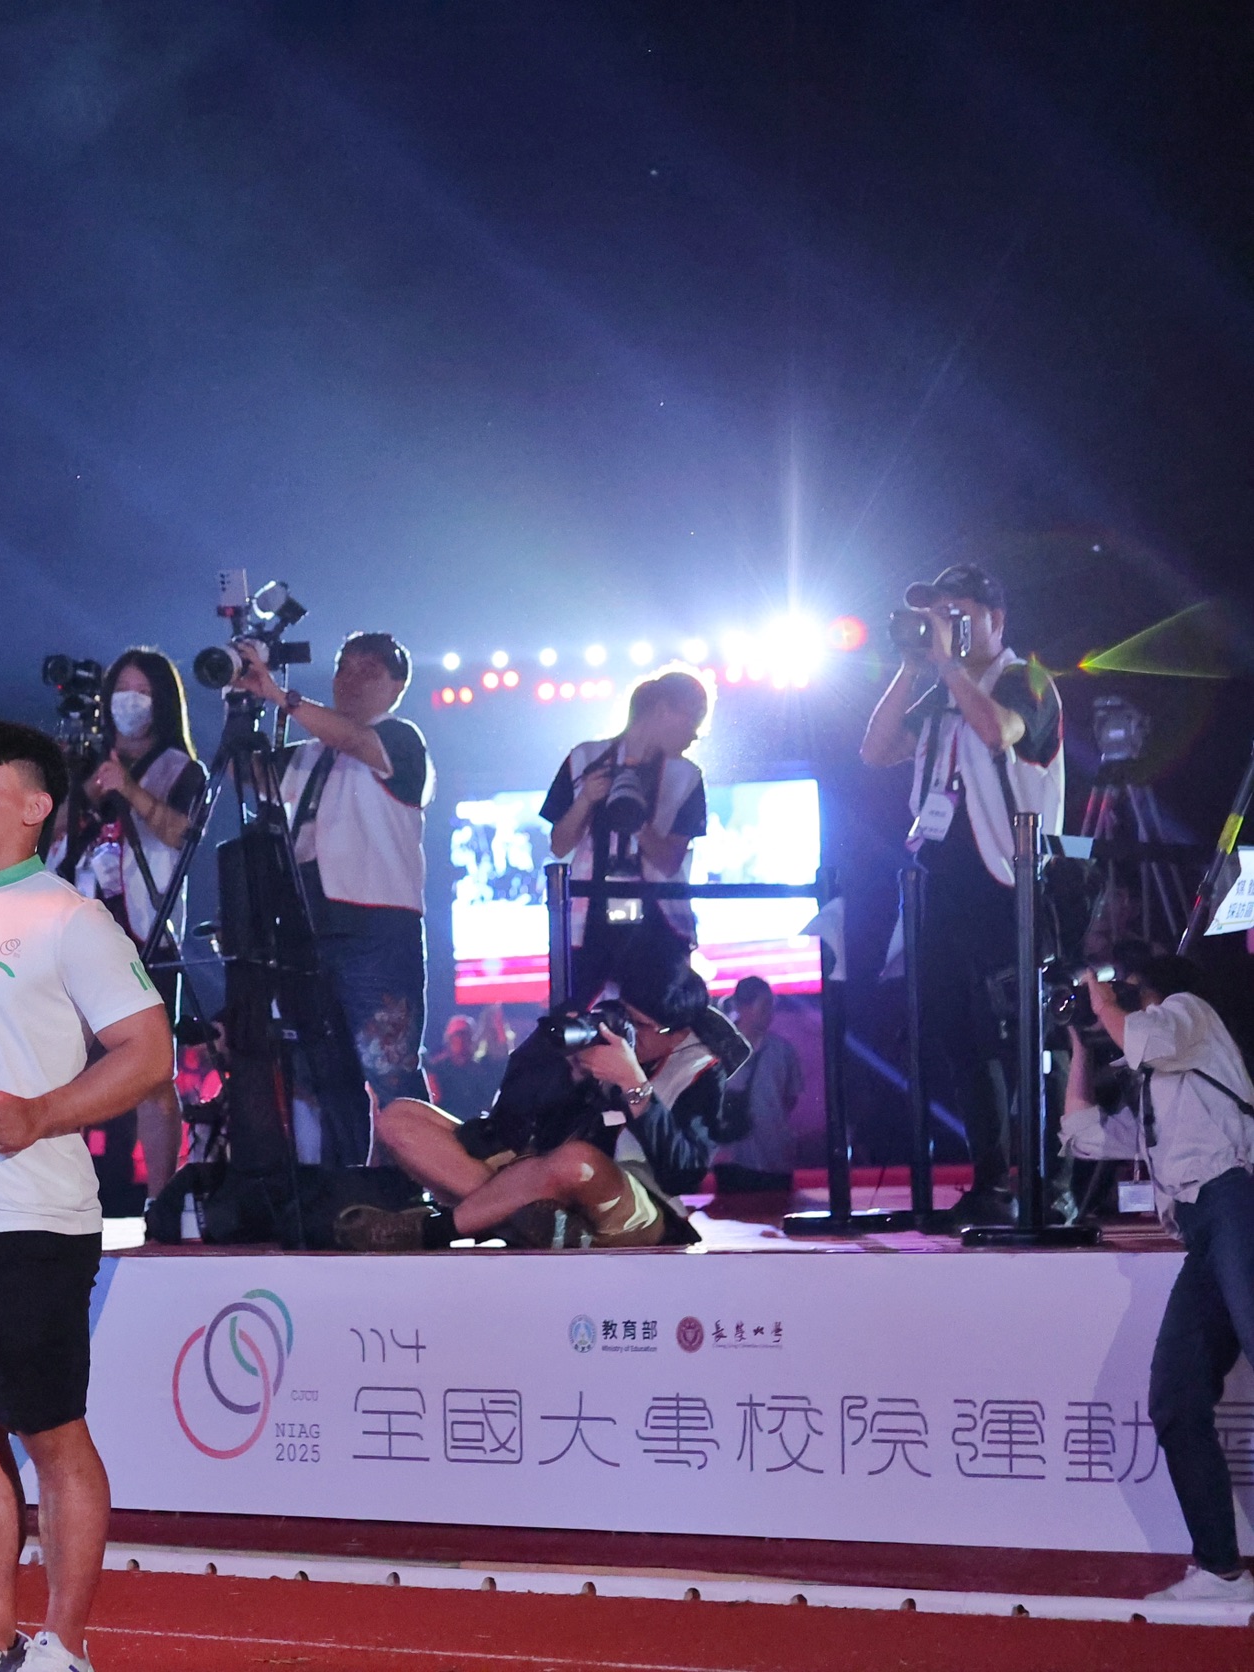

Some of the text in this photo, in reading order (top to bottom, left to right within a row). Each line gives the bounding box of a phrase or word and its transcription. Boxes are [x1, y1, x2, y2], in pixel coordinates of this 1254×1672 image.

[601, 1319, 658, 1340] 教育部
[349, 1327, 427, 1364] 114
[275, 1422, 321, 1439] NIAG
[275, 1443, 321, 1463] 2025
